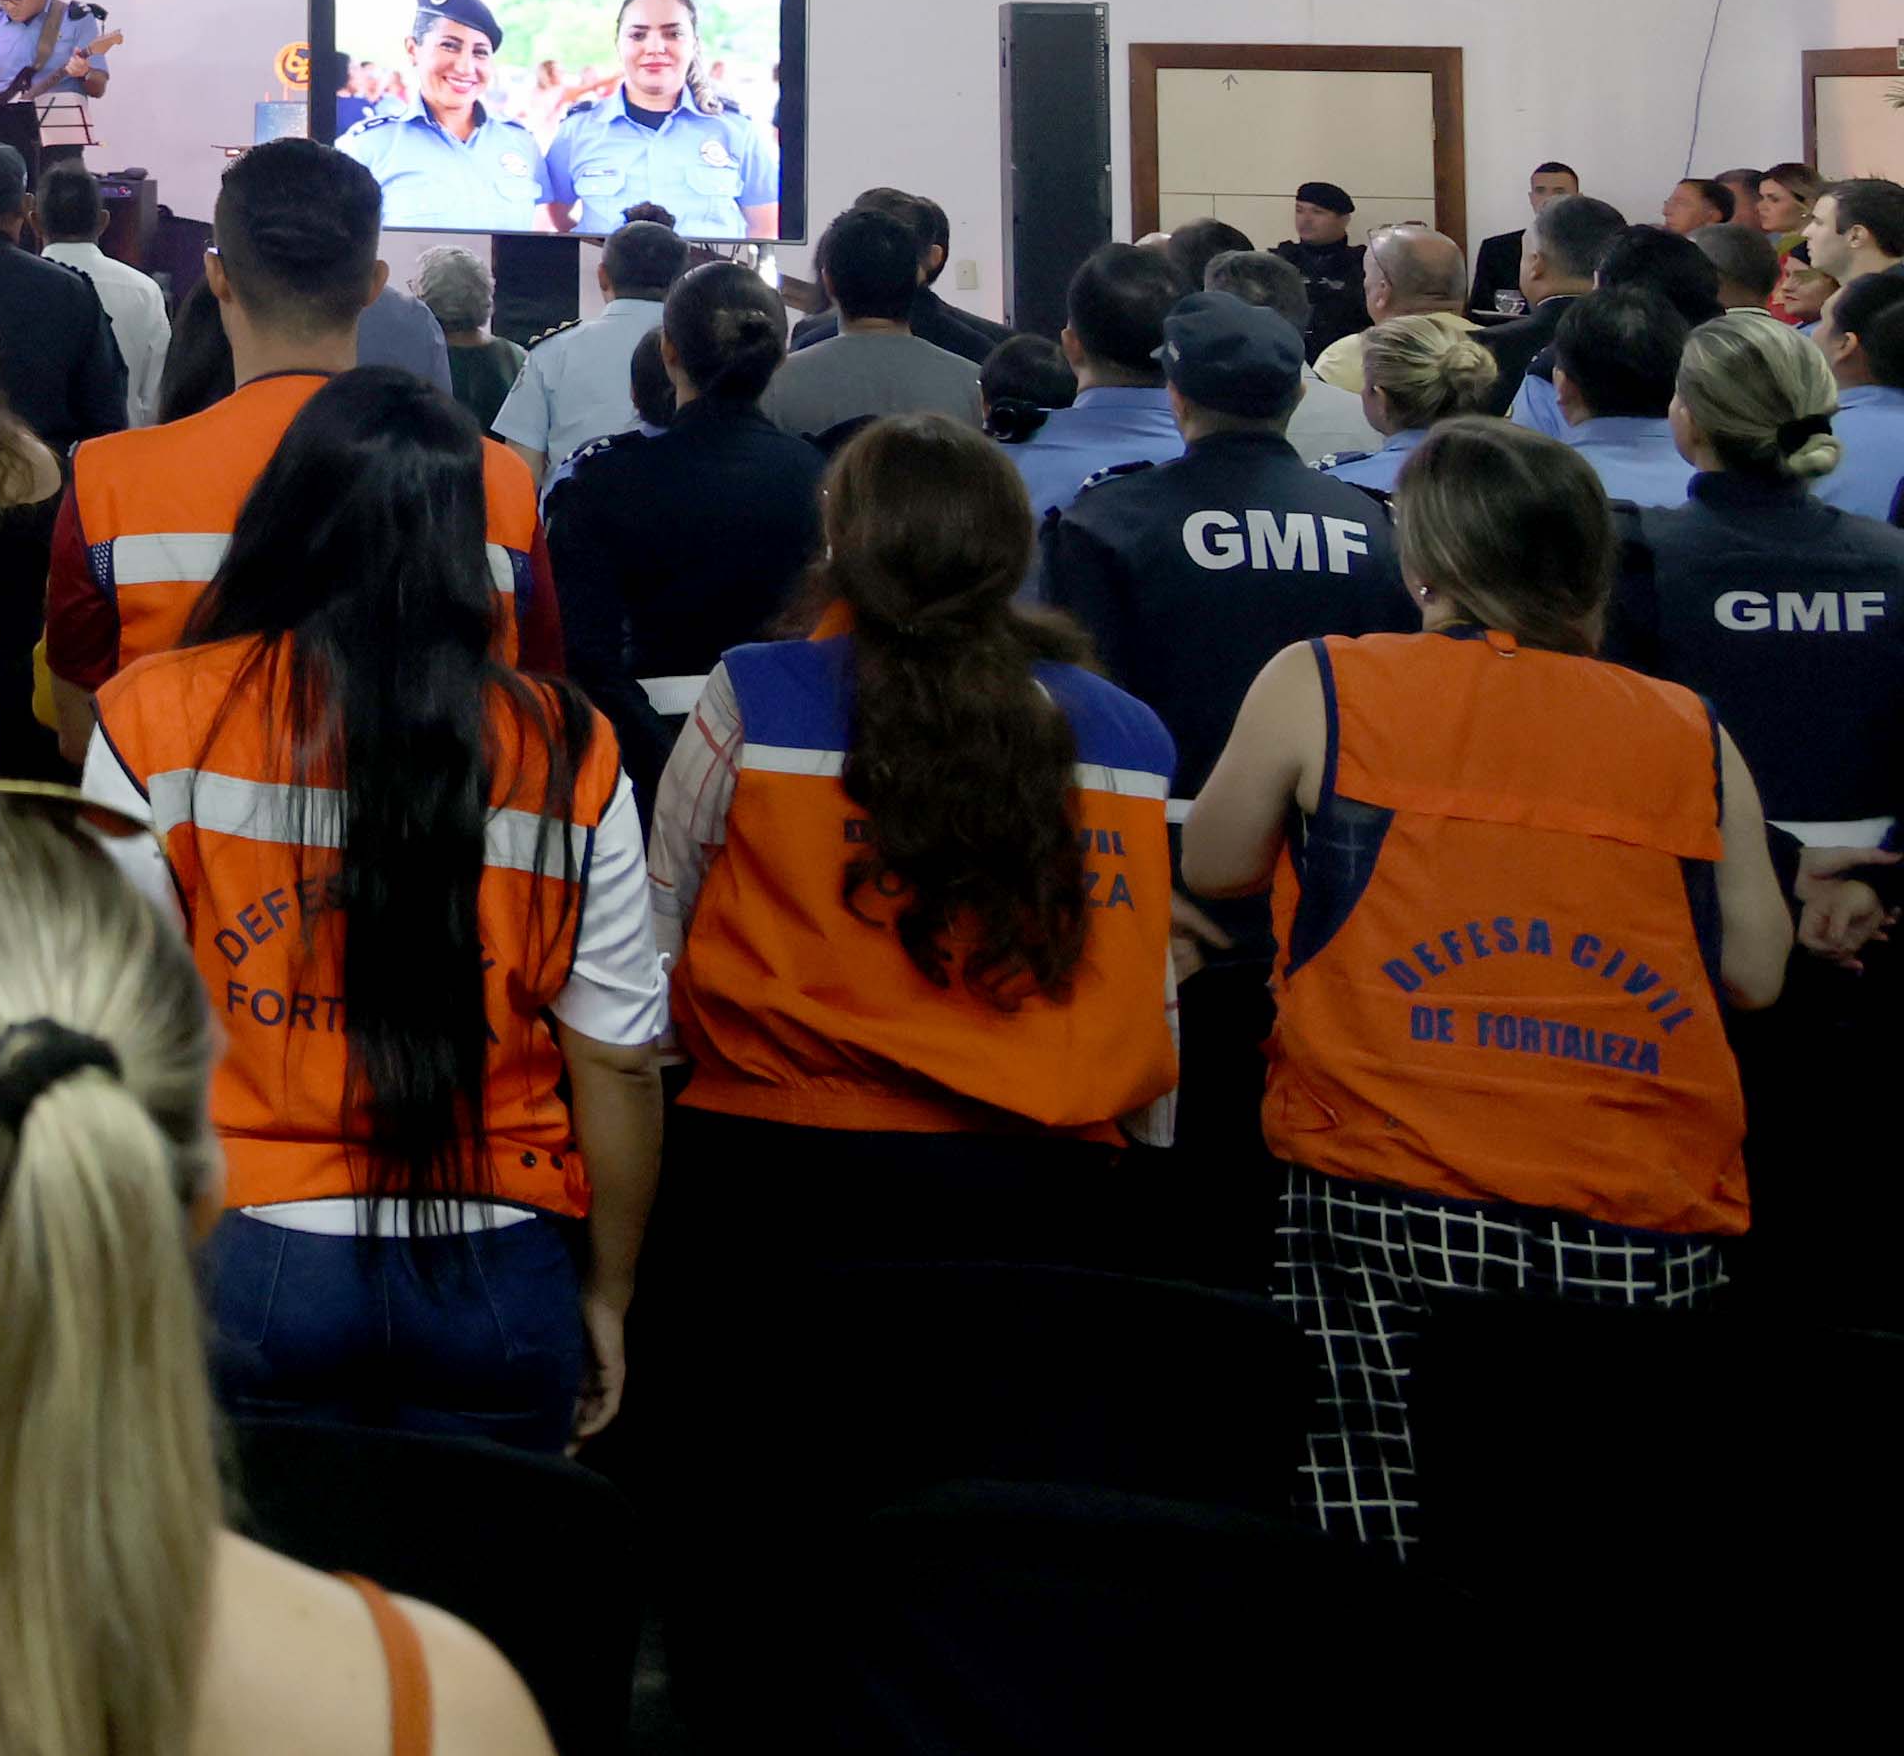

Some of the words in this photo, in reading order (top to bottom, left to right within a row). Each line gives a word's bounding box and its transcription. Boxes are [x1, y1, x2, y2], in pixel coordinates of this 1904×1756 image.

[1182, 509, 1369, 575] GMF
[1714, 590, 1886, 632] GMF
[1381, 916, 1553, 993] DEFESA
[1570, 933, 1694, 1035] CIVIL
[1410, 1004, 1455, 1043] DE
[1476, 1011, 1660, 1076] FORTALEZA
